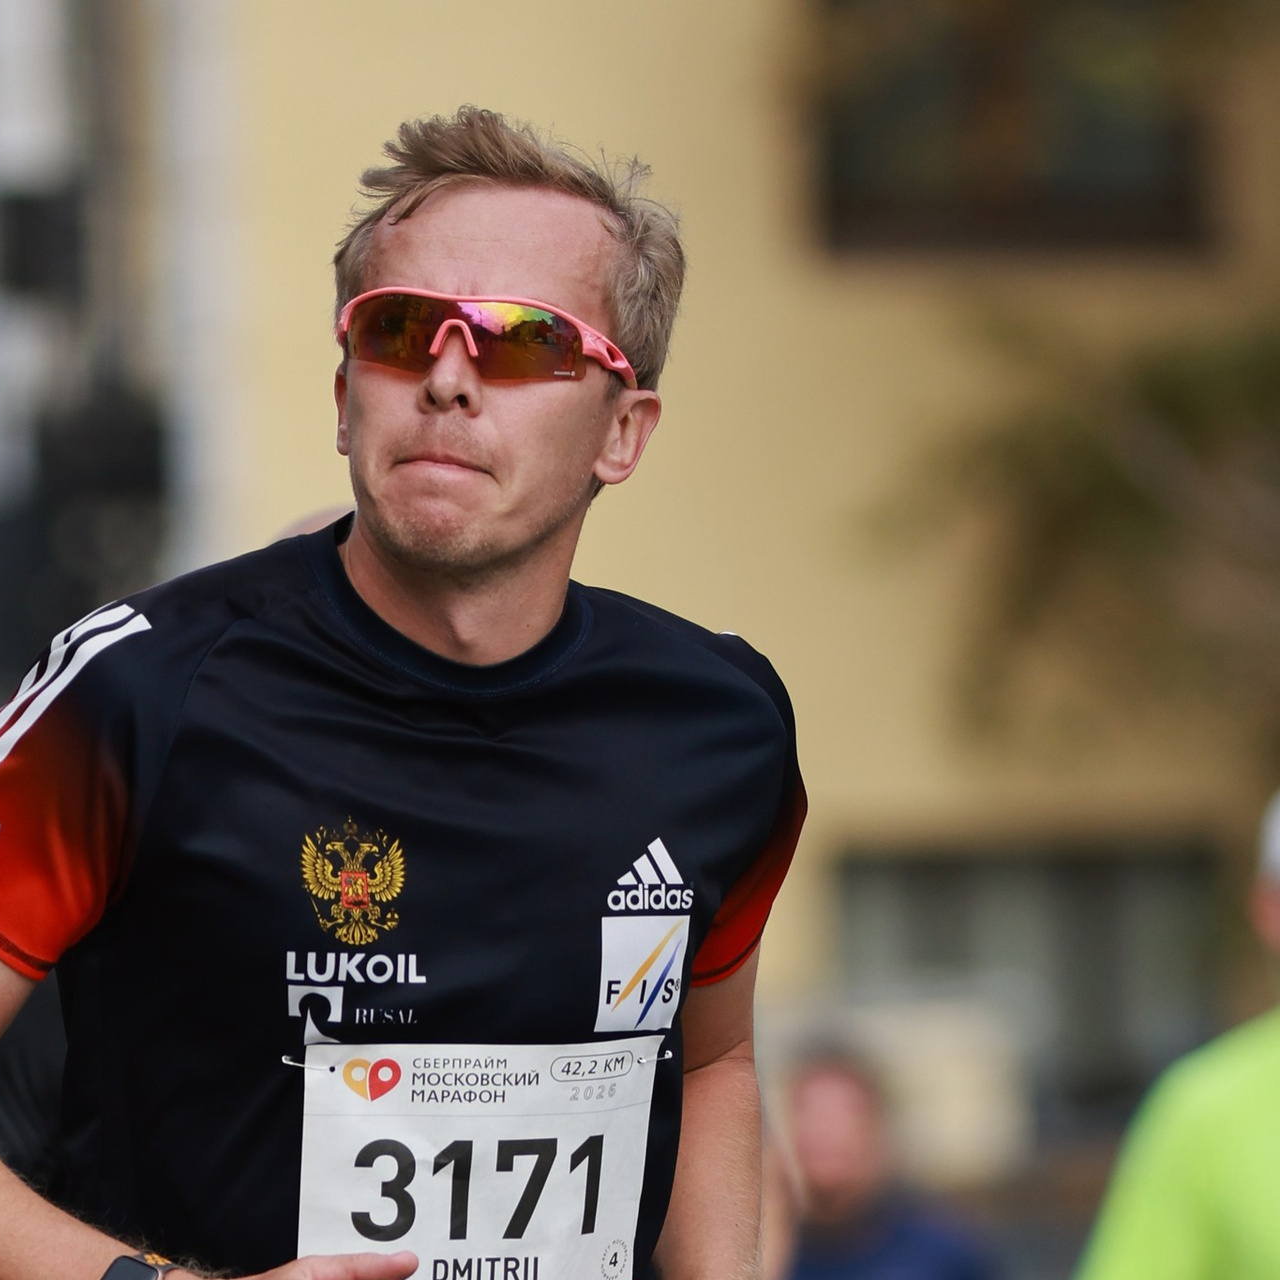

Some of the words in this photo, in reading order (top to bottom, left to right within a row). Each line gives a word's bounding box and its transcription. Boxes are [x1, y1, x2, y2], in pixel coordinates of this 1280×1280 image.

[606, 883, 695, 911] adidas
[286, 951, 427, 984] LUKOIL
[355, 1008, 419, 1024] RUSAL
[412, 1056, 508, 1070] СБЕРПРАЙМ
[561, 1060, 598, 1077] 42,2
[411, 1069, 540, 1087] МОСКОВСКИЙ
[411, 1090, 506, 1104] МАРАФОН
[570, 1082, 617, 1101] 2026
[351, 1134, 605, 1242] 3171
[609, 1252, 618, 1267] 4
